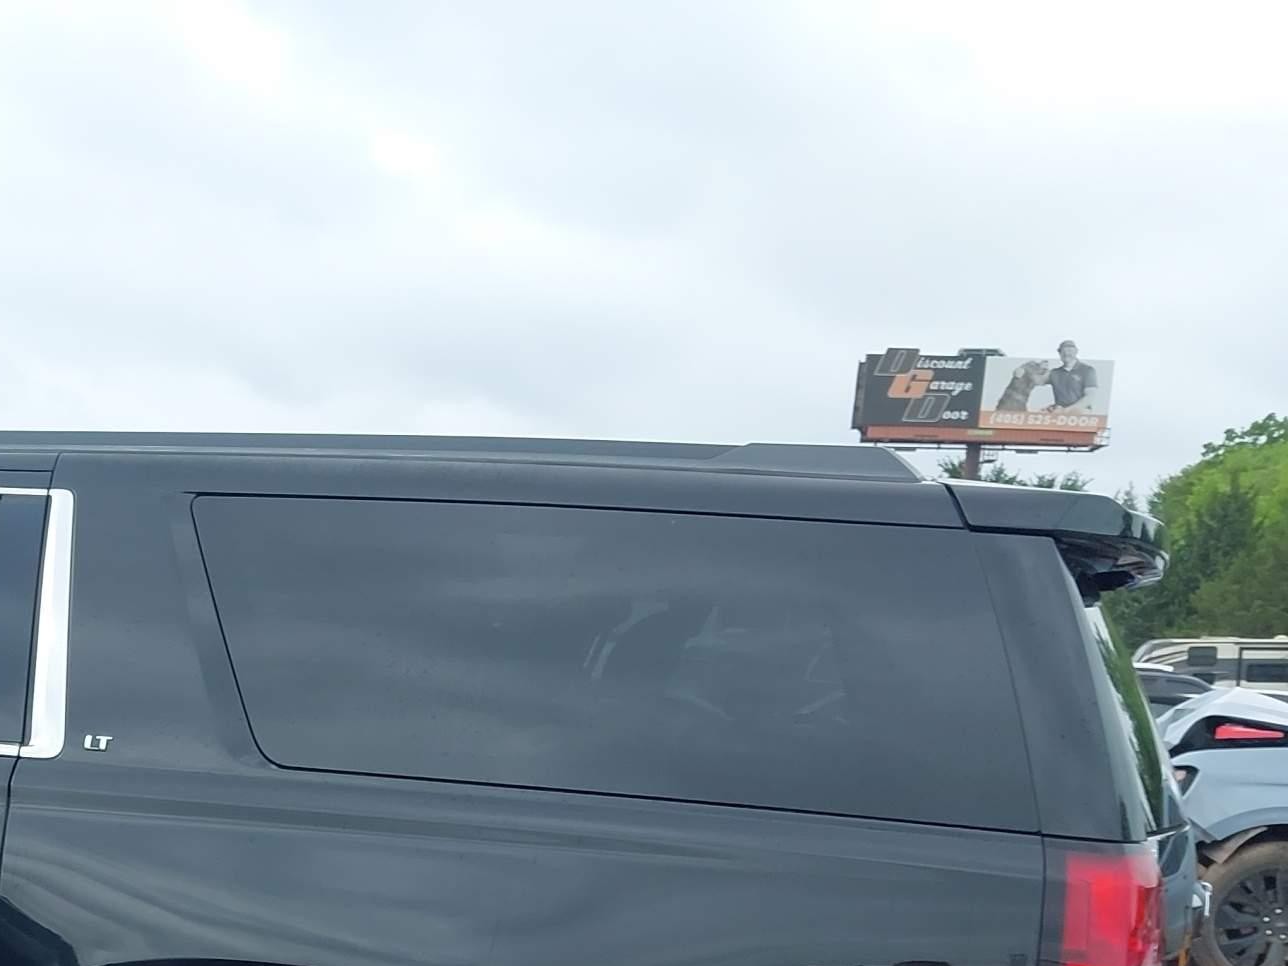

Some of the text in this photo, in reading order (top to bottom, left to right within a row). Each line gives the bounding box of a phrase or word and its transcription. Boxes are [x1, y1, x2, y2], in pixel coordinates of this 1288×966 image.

[874, 348, 974, 376] Discount
[888, 369, 973, 398] Garage
[902, 393, 969, 422] Door
[84, 735, 113, 750] LT
